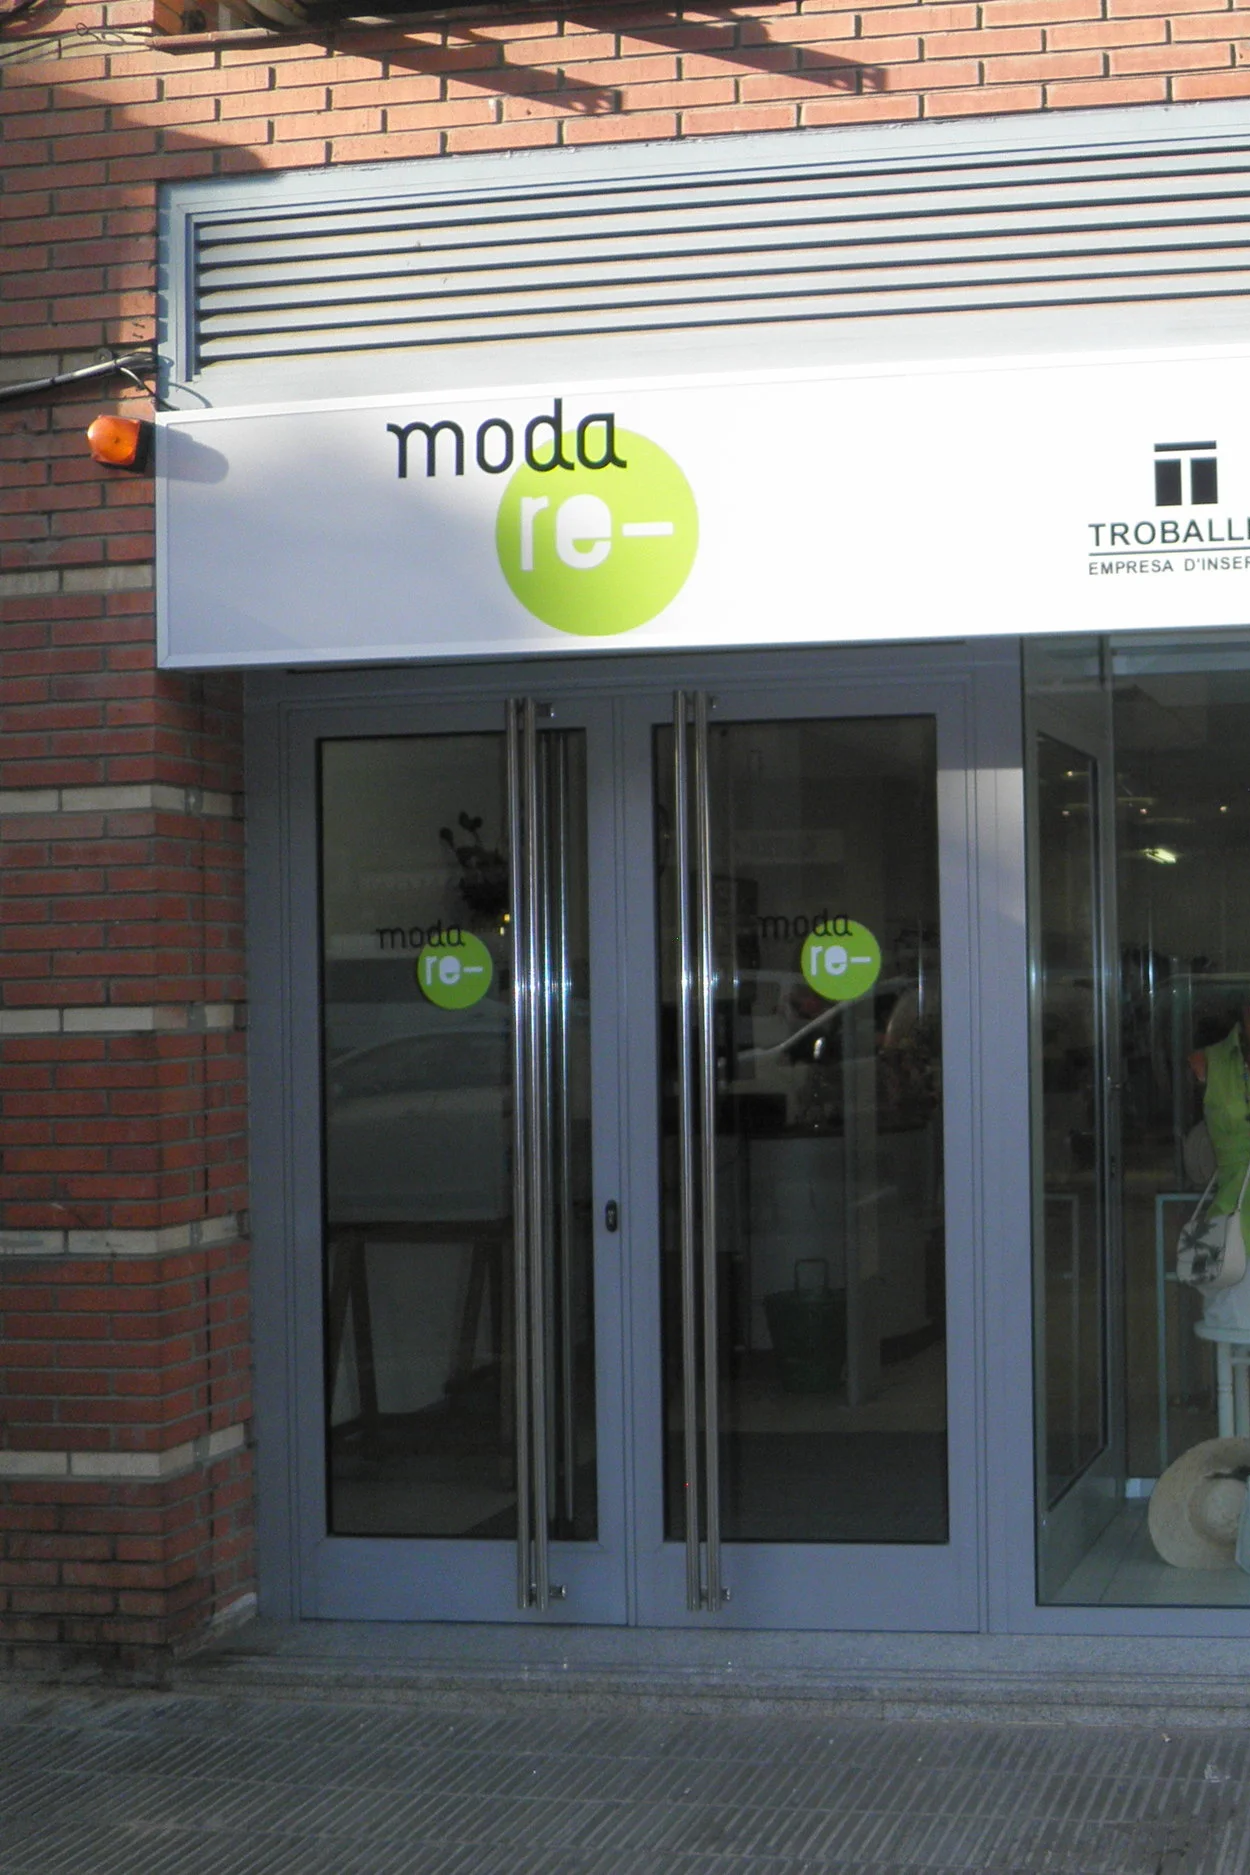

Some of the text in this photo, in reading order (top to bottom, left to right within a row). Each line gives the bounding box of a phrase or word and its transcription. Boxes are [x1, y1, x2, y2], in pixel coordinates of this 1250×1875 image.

[386, 397, 628, 479] moda
[1088, 559, 1174, 576] EMPRESA
[376, 919, 466, 949] moda
[757, 907, 853, 939] moda
